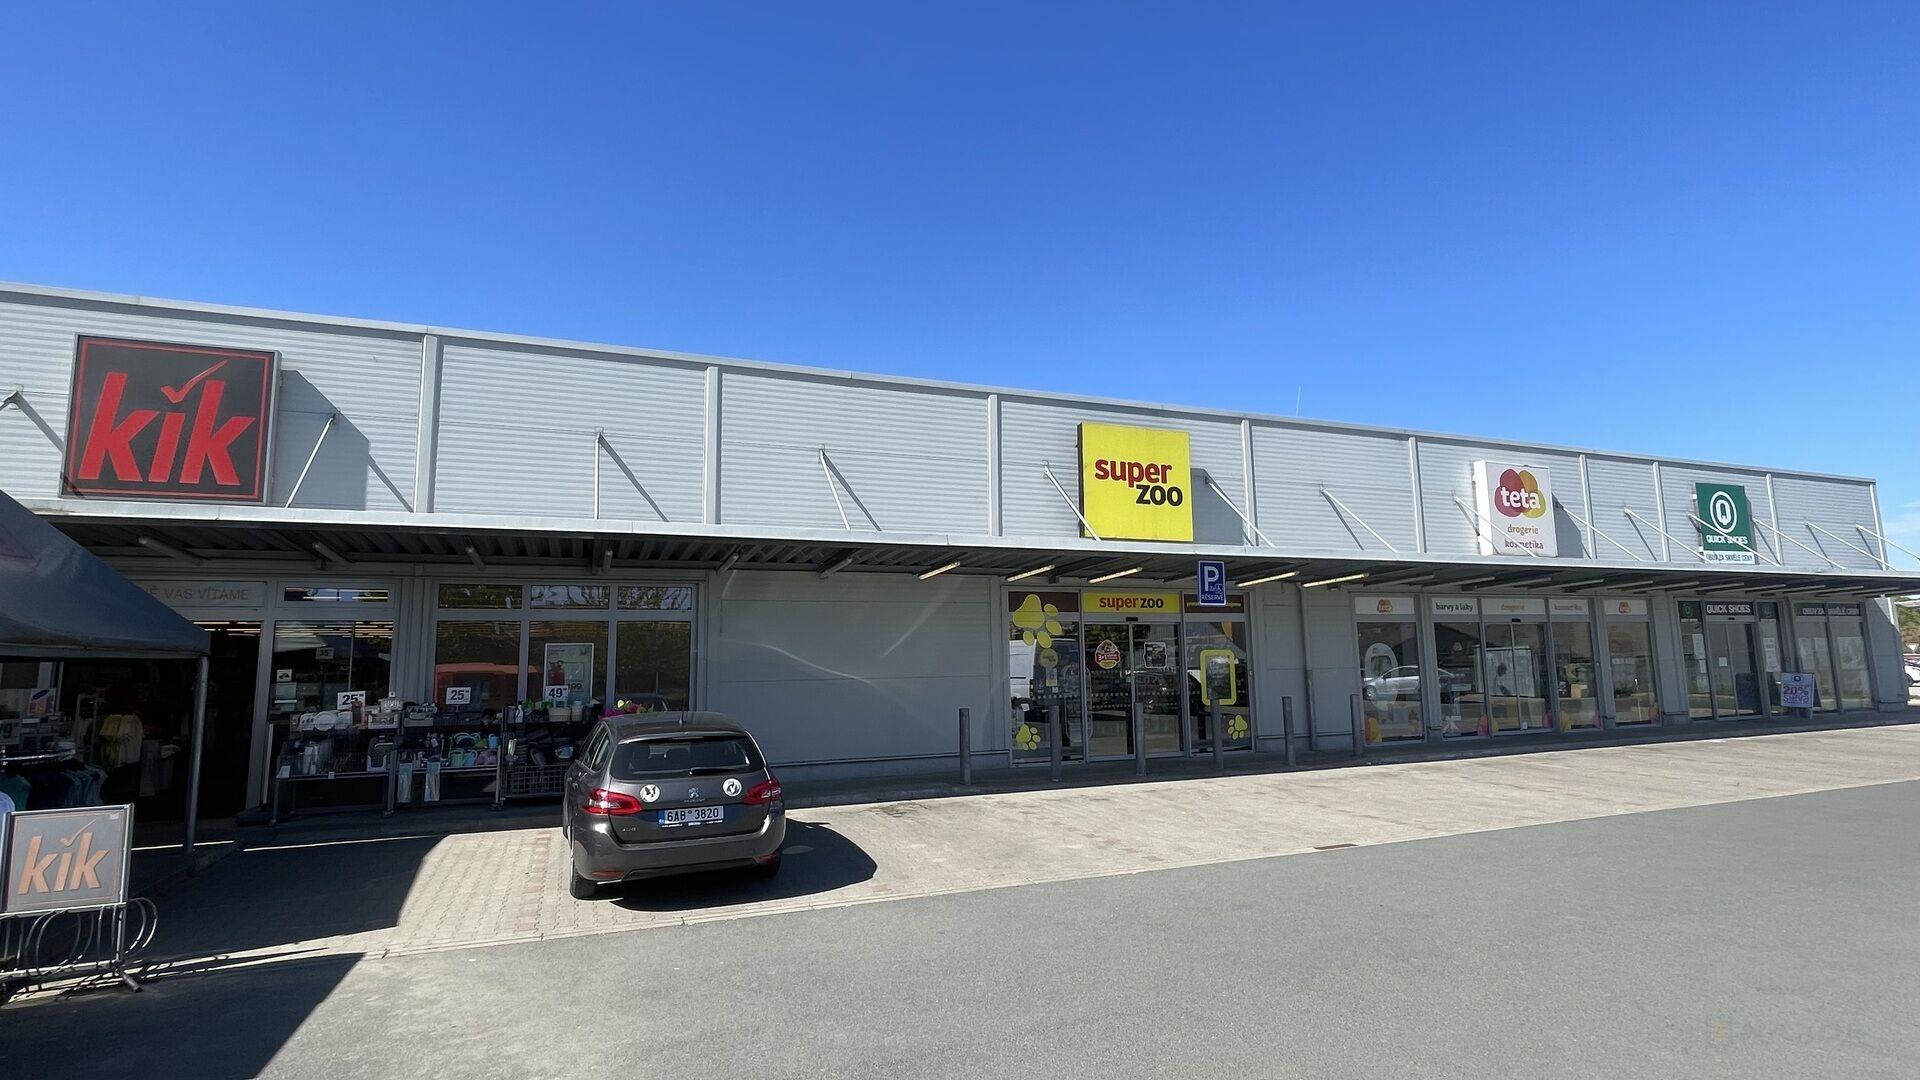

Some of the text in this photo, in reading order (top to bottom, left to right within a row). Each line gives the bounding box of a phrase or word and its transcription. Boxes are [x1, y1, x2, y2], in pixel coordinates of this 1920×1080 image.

[1094, 459, 1173, 488] super
[1135, 484, 1184, 507] zoo
[1500, 486, 1541, 509] teta
[1507, 523, 1540, 537] drogerie
[1706, 534, 1727, 544] QUICK
[1204, 566, 1219, 591] P
[1099, 594, 1164, 611] super zoo
[1435, 602, 1455, 612] barvy
[1459, 602, 1473, 612] laky
[1706, 604, 1751, 613] QUICK SHOES
[451, 689, 465, 701] 25
[549, 688, 563, 698] 49
[1783, 686, 1809, 696] 20%
[667, 810, 686, 822] 6AB
[694, 808, 719, 820] 3820
